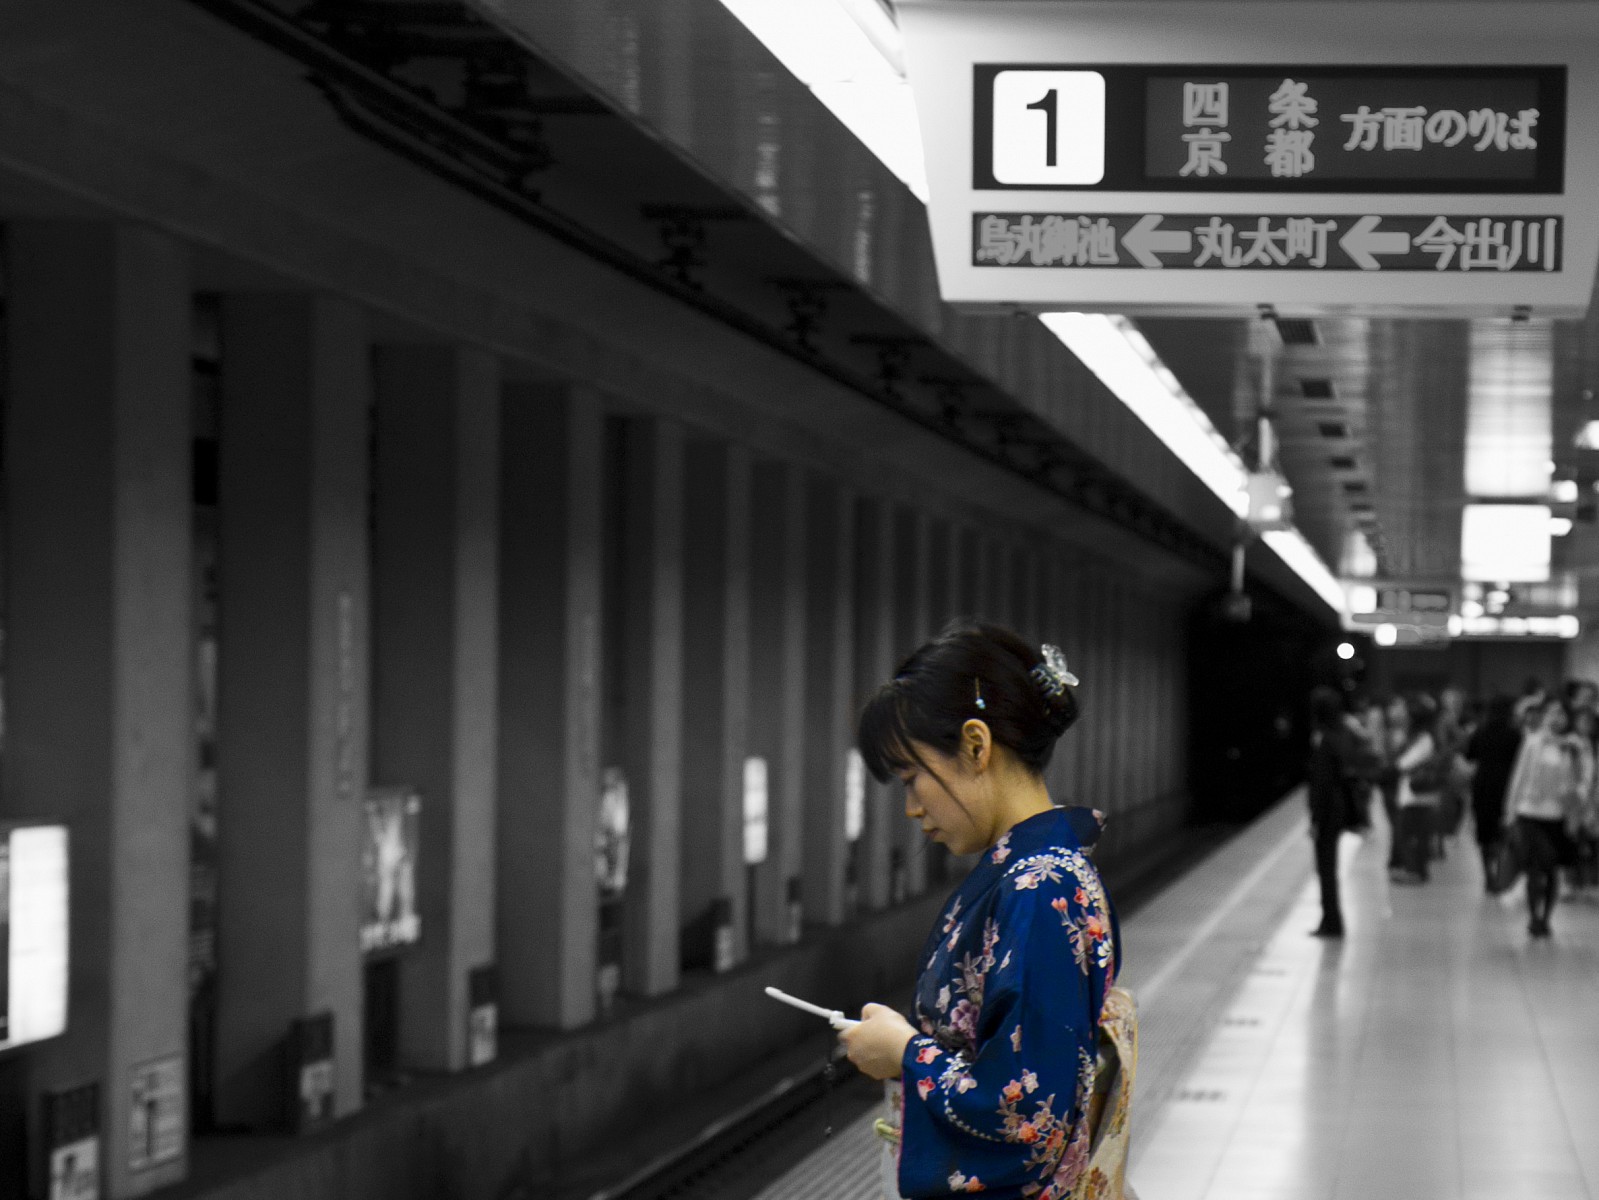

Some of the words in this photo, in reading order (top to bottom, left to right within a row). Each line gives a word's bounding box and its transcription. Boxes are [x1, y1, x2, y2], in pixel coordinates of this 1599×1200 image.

[1026, 88, 1058, 168] 1
[1183, 78, 1319, 130] 四条
[1339, 106, 1540, 151] 方面のりば
[1179, 128, 1315, 177] 京都
[1193, 216, 1338, 268] 丸太町
[1412, 215, 1558, 272] 今出川
